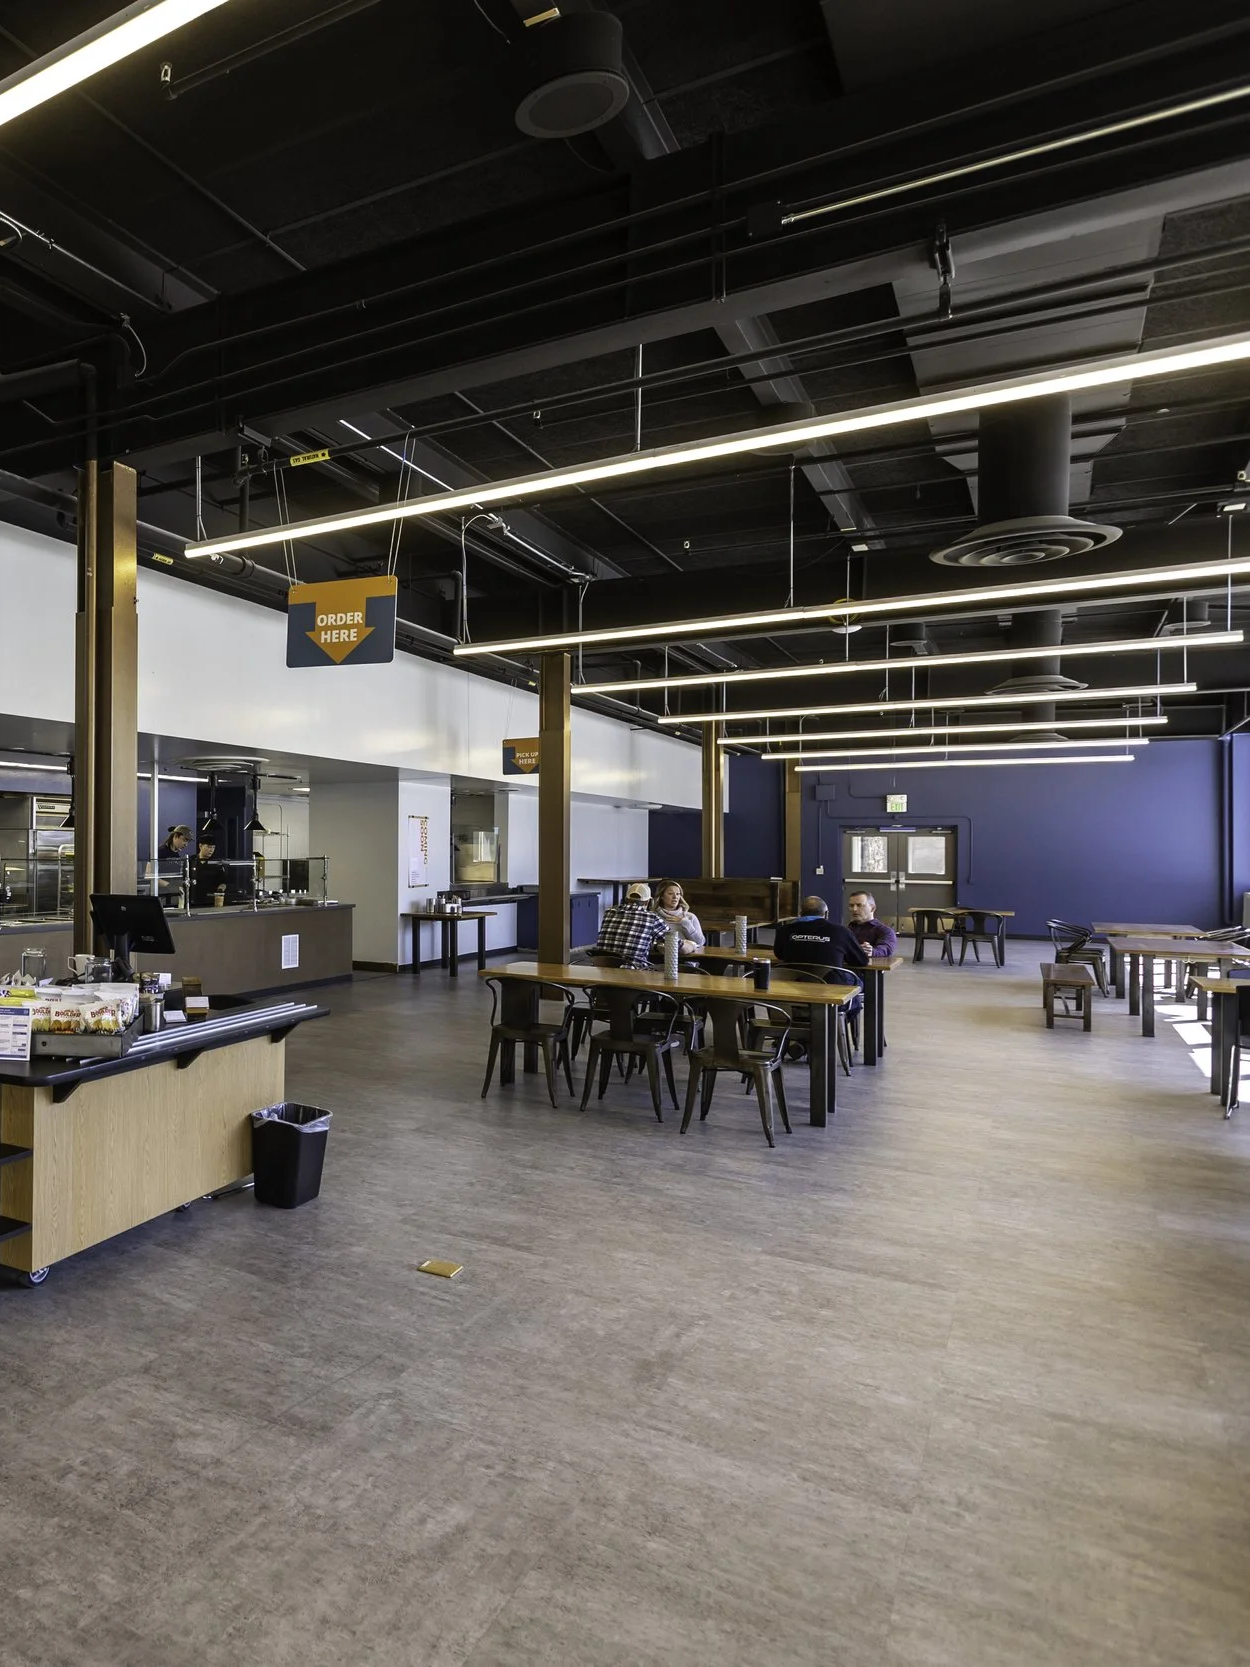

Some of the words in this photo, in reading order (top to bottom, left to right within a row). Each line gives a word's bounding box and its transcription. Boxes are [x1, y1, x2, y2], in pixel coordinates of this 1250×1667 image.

[317, 611, 363, 626] ORDER
[321, 628, 358, 643] HERE
[891, 803, 903, 811] EXIT
[55, 1009, 82, 1018] BOULDER
[90, 1006, 116, 1018] BOULDER
